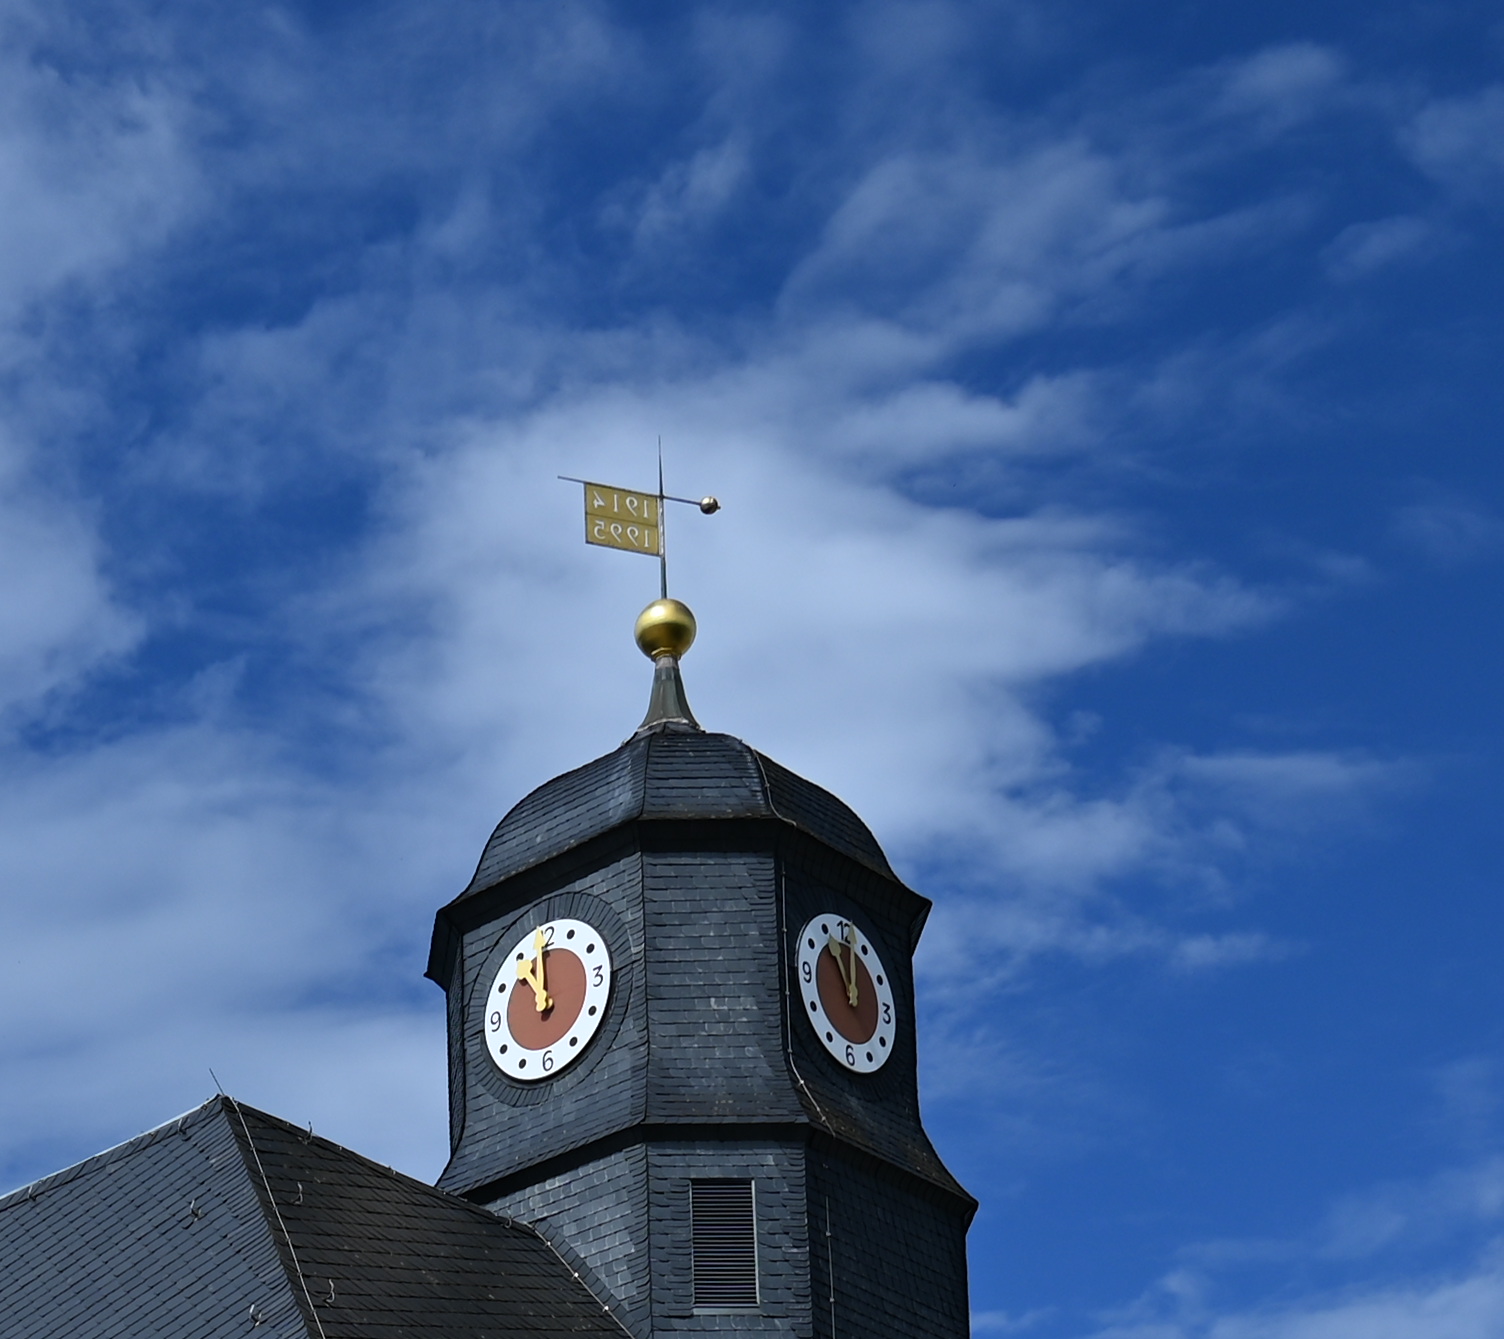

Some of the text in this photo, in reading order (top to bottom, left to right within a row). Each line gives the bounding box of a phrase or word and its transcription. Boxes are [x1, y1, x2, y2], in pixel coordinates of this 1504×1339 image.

[592, 964, 604, 987] 3
[802, 961, 812, 983] 9
[490, 1011, 502, 1032] 9
[882, 1002, 892, 1025] 3
[542, 1050, 554, 1072] 6
[845, 1045, 856, 1066] 6
